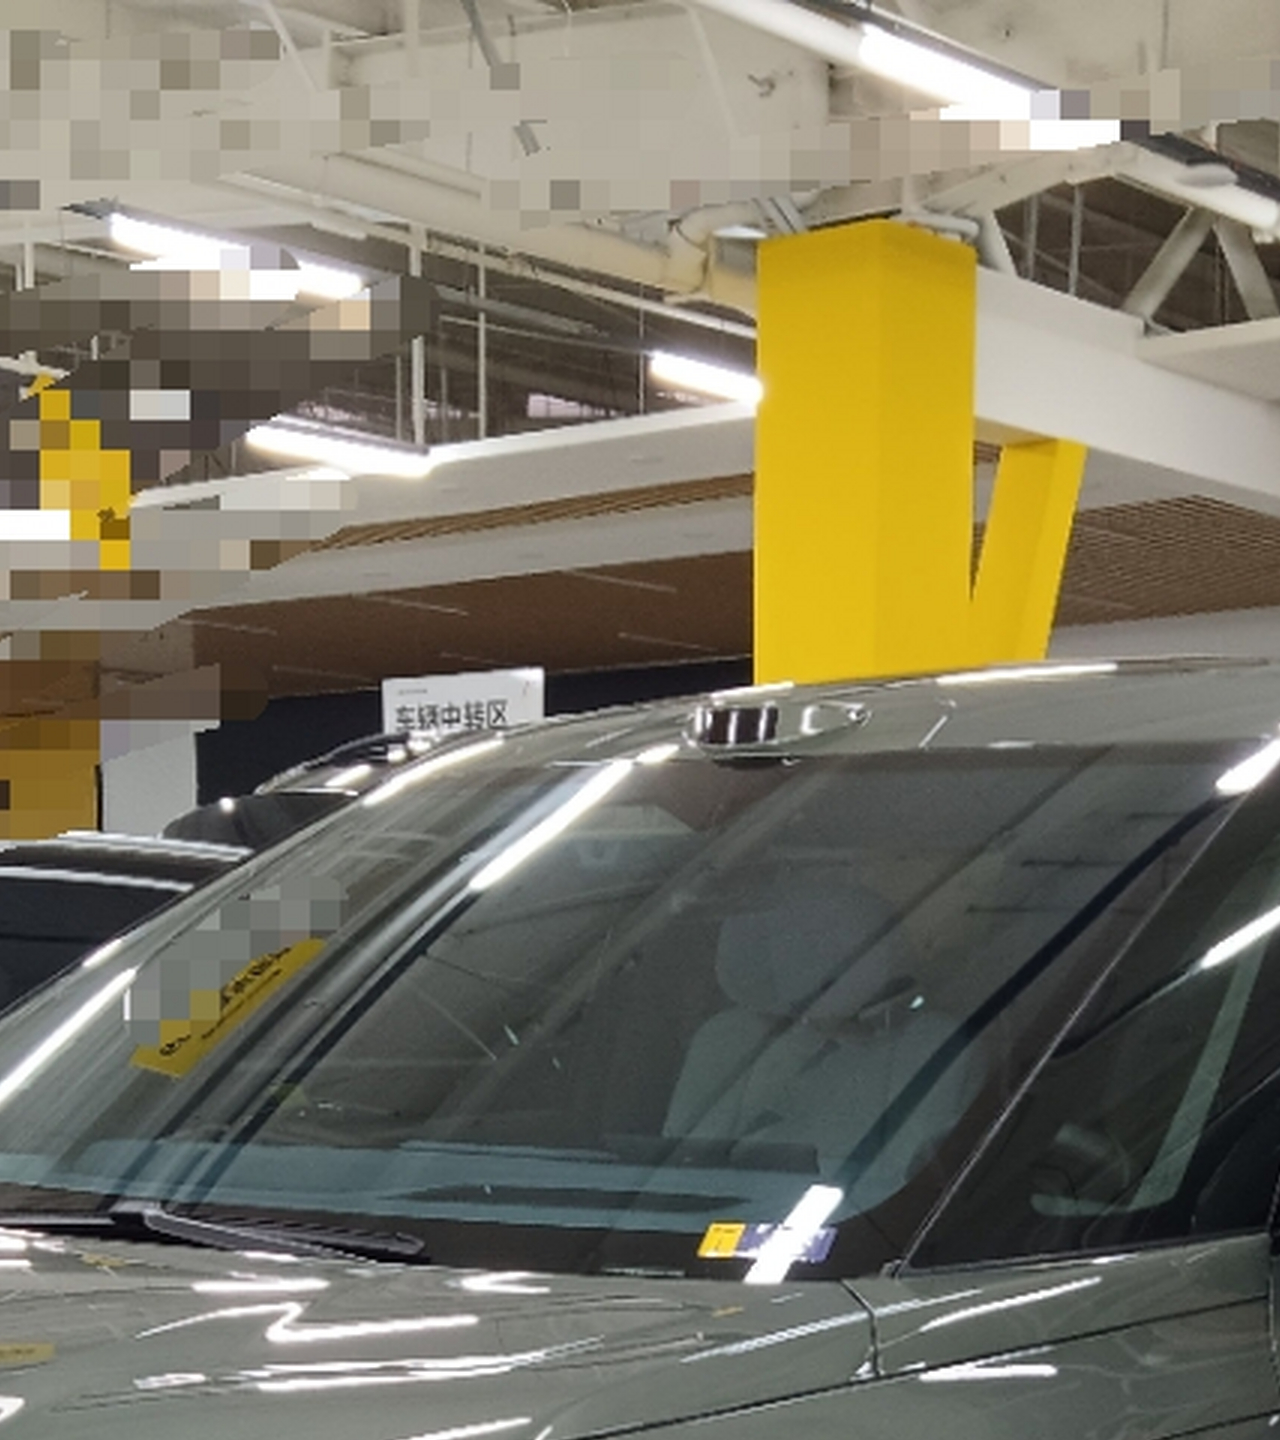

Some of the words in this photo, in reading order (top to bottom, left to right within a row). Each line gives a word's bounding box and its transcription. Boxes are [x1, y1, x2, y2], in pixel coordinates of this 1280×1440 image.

[395, 700, 508, 731] 车辆中转区
